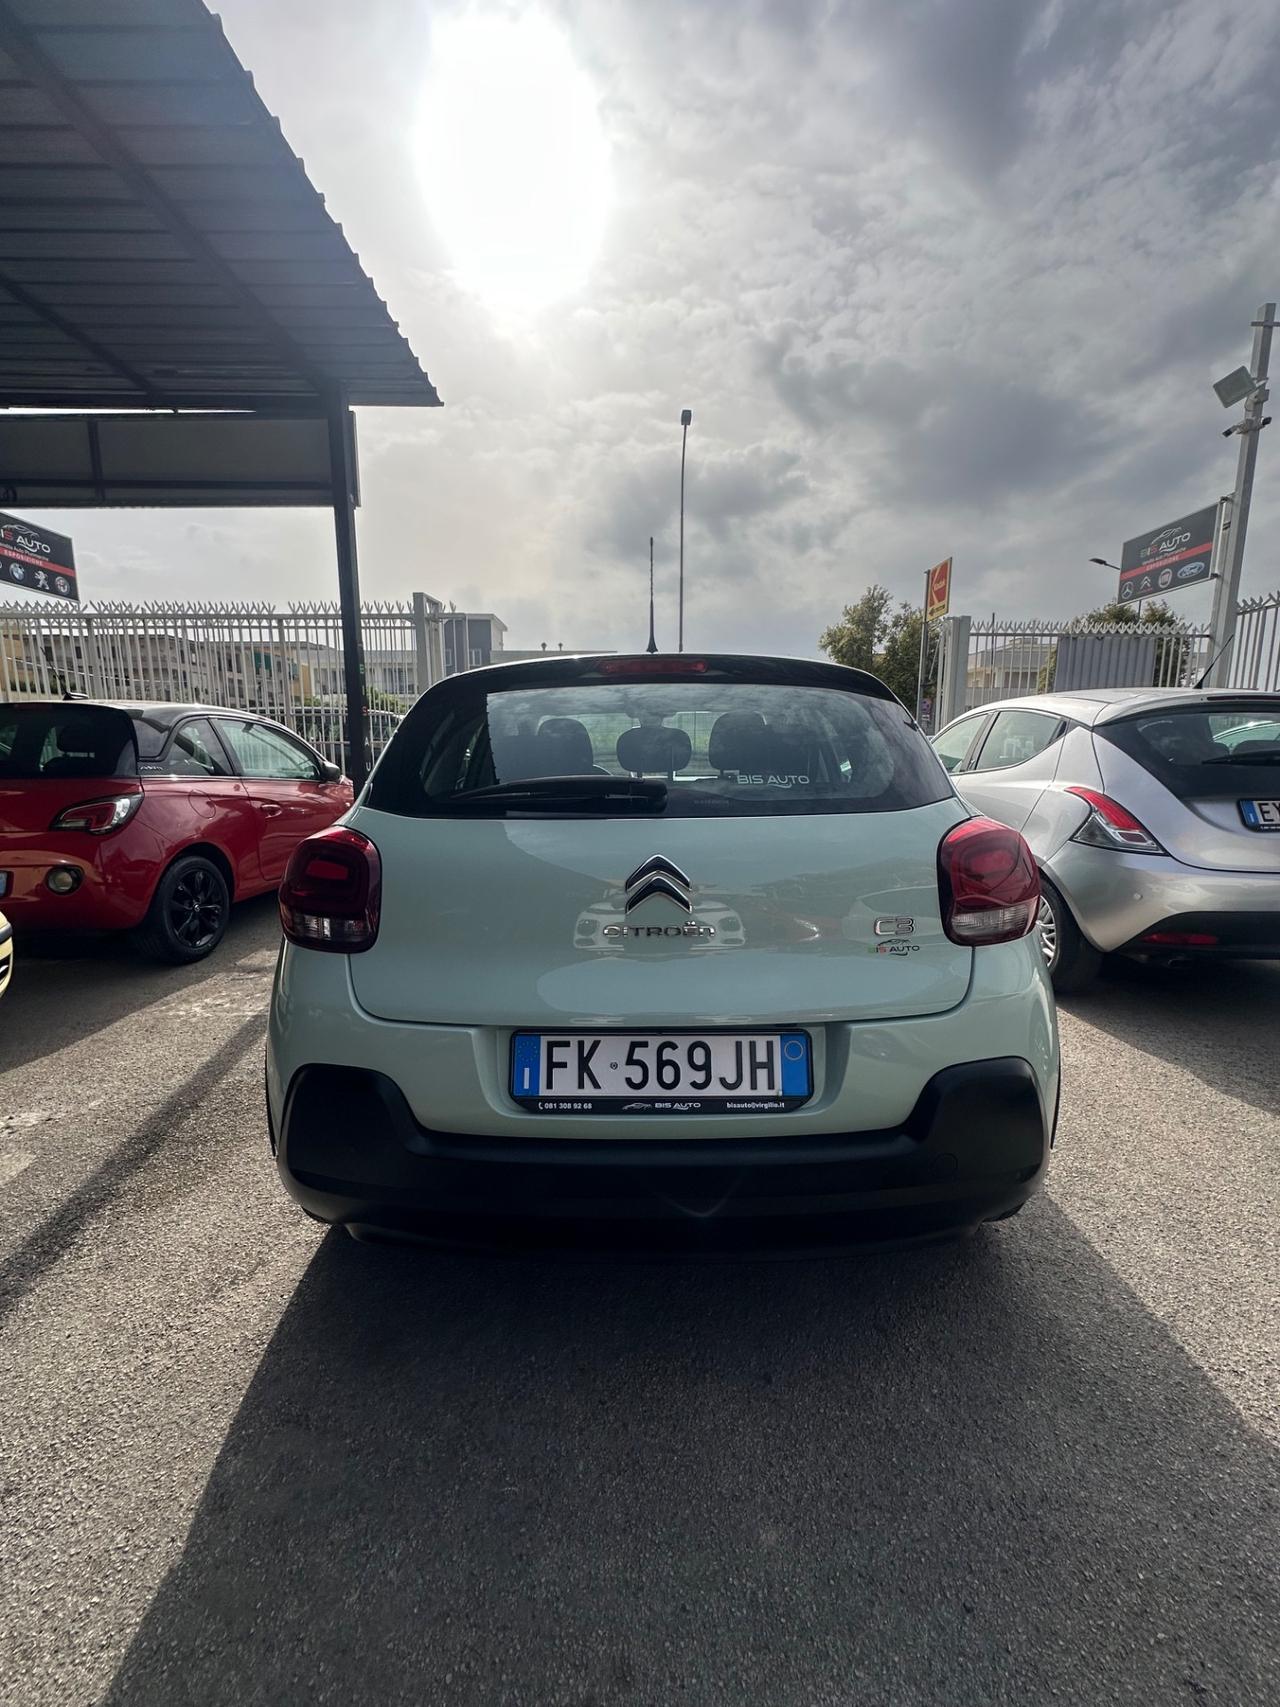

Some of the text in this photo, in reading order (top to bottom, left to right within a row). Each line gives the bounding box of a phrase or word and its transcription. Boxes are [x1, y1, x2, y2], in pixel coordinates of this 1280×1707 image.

[16, 535, 51, 553] AUTO
[1159, 532, 1191, 551] AUTO
[737, 775, 810, 787] BIS AUTO
[873, 917, 914, 936] C3
[889, 945, 920, 953] AUTO
[545, 1039, 602, 1090] FK
[573, 1102, 581, 1110] 92
[673, 1102, 701, 1110] AUTO
